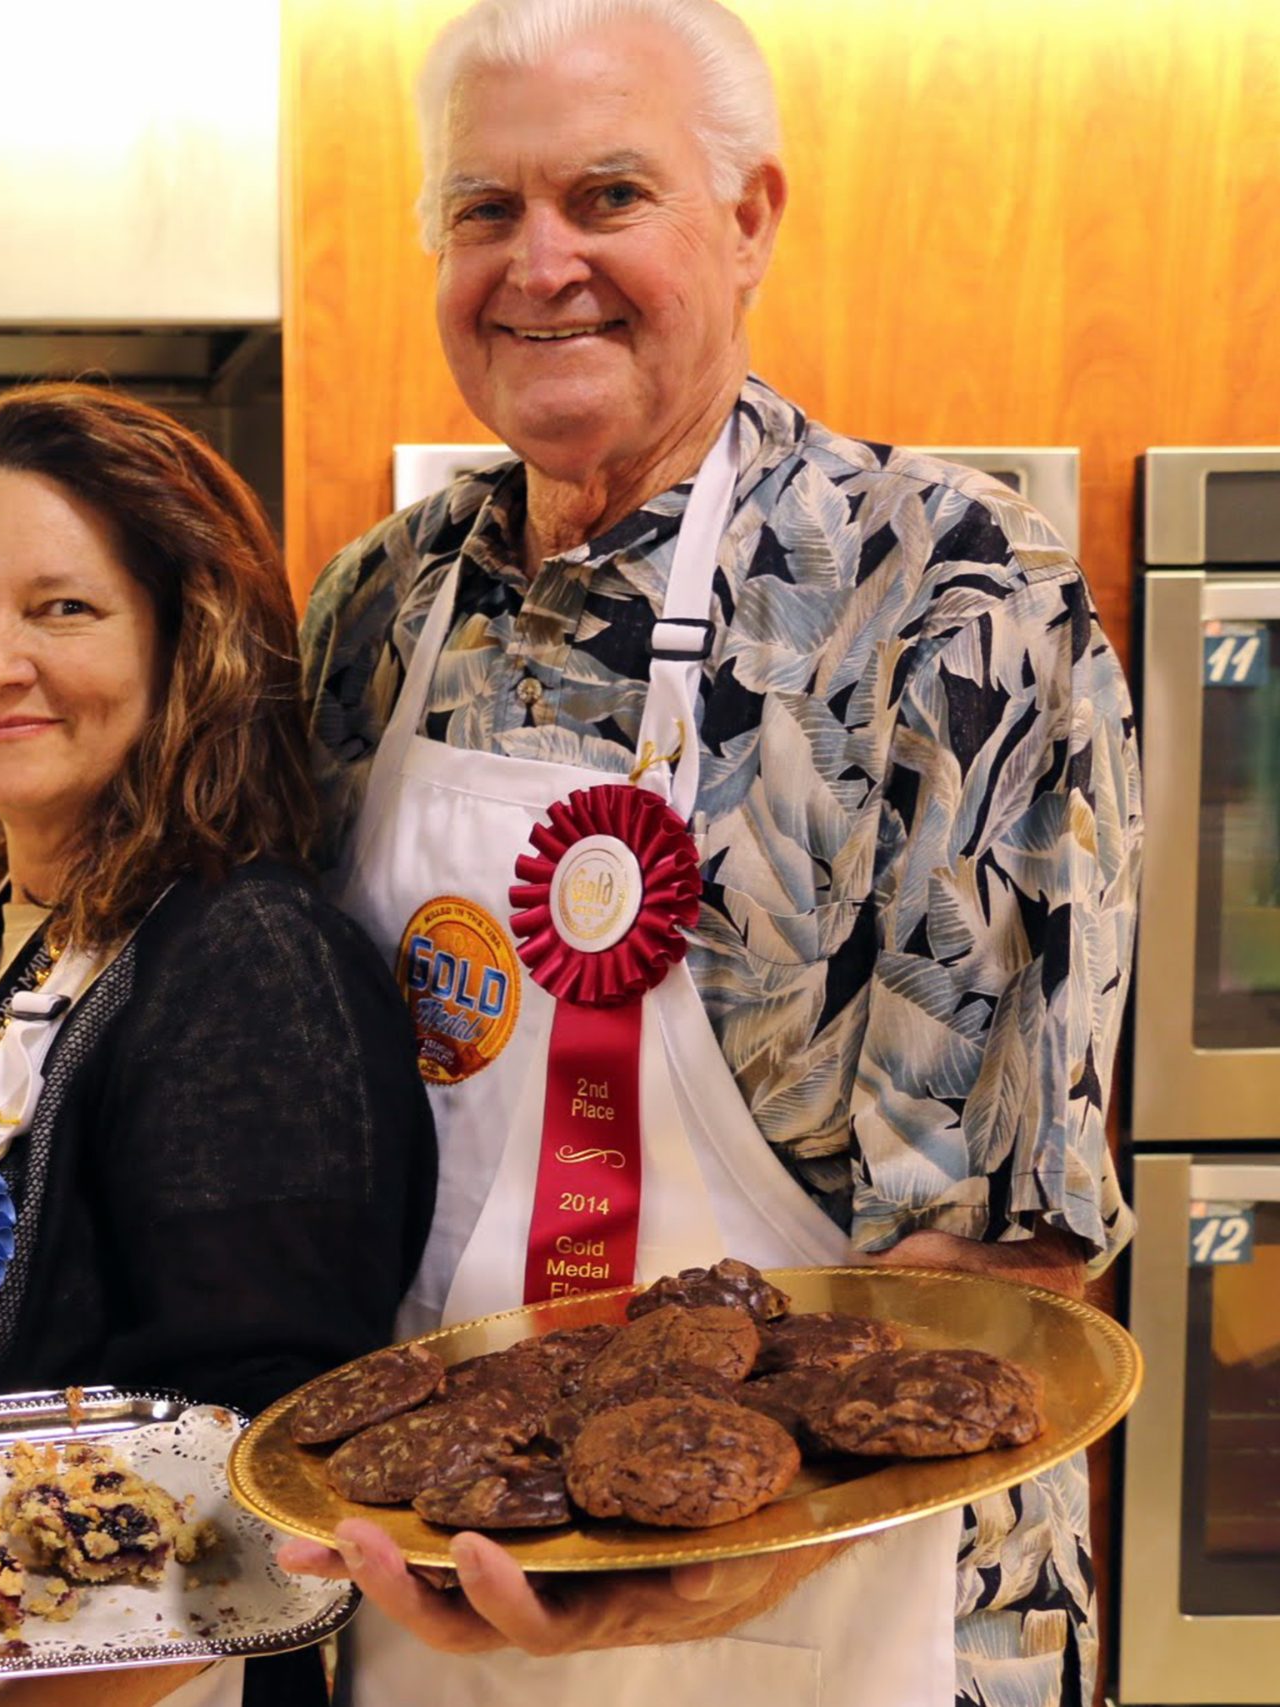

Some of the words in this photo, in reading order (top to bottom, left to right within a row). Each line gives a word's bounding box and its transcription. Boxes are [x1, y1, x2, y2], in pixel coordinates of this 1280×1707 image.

[1208, 637, 1260, 682] 11
[407, 936, 508, 1018] GOLD
[576, 1077, 609, 1099] 2nd
[571, 1098, 616, 1121] Place
[558, 1192, 610, 1216] 2014
[555, 1235, 605, 1257] Gold
[546, 1258, 610, 1279] Medal
[550, 1281, 588, 1299] Flo
